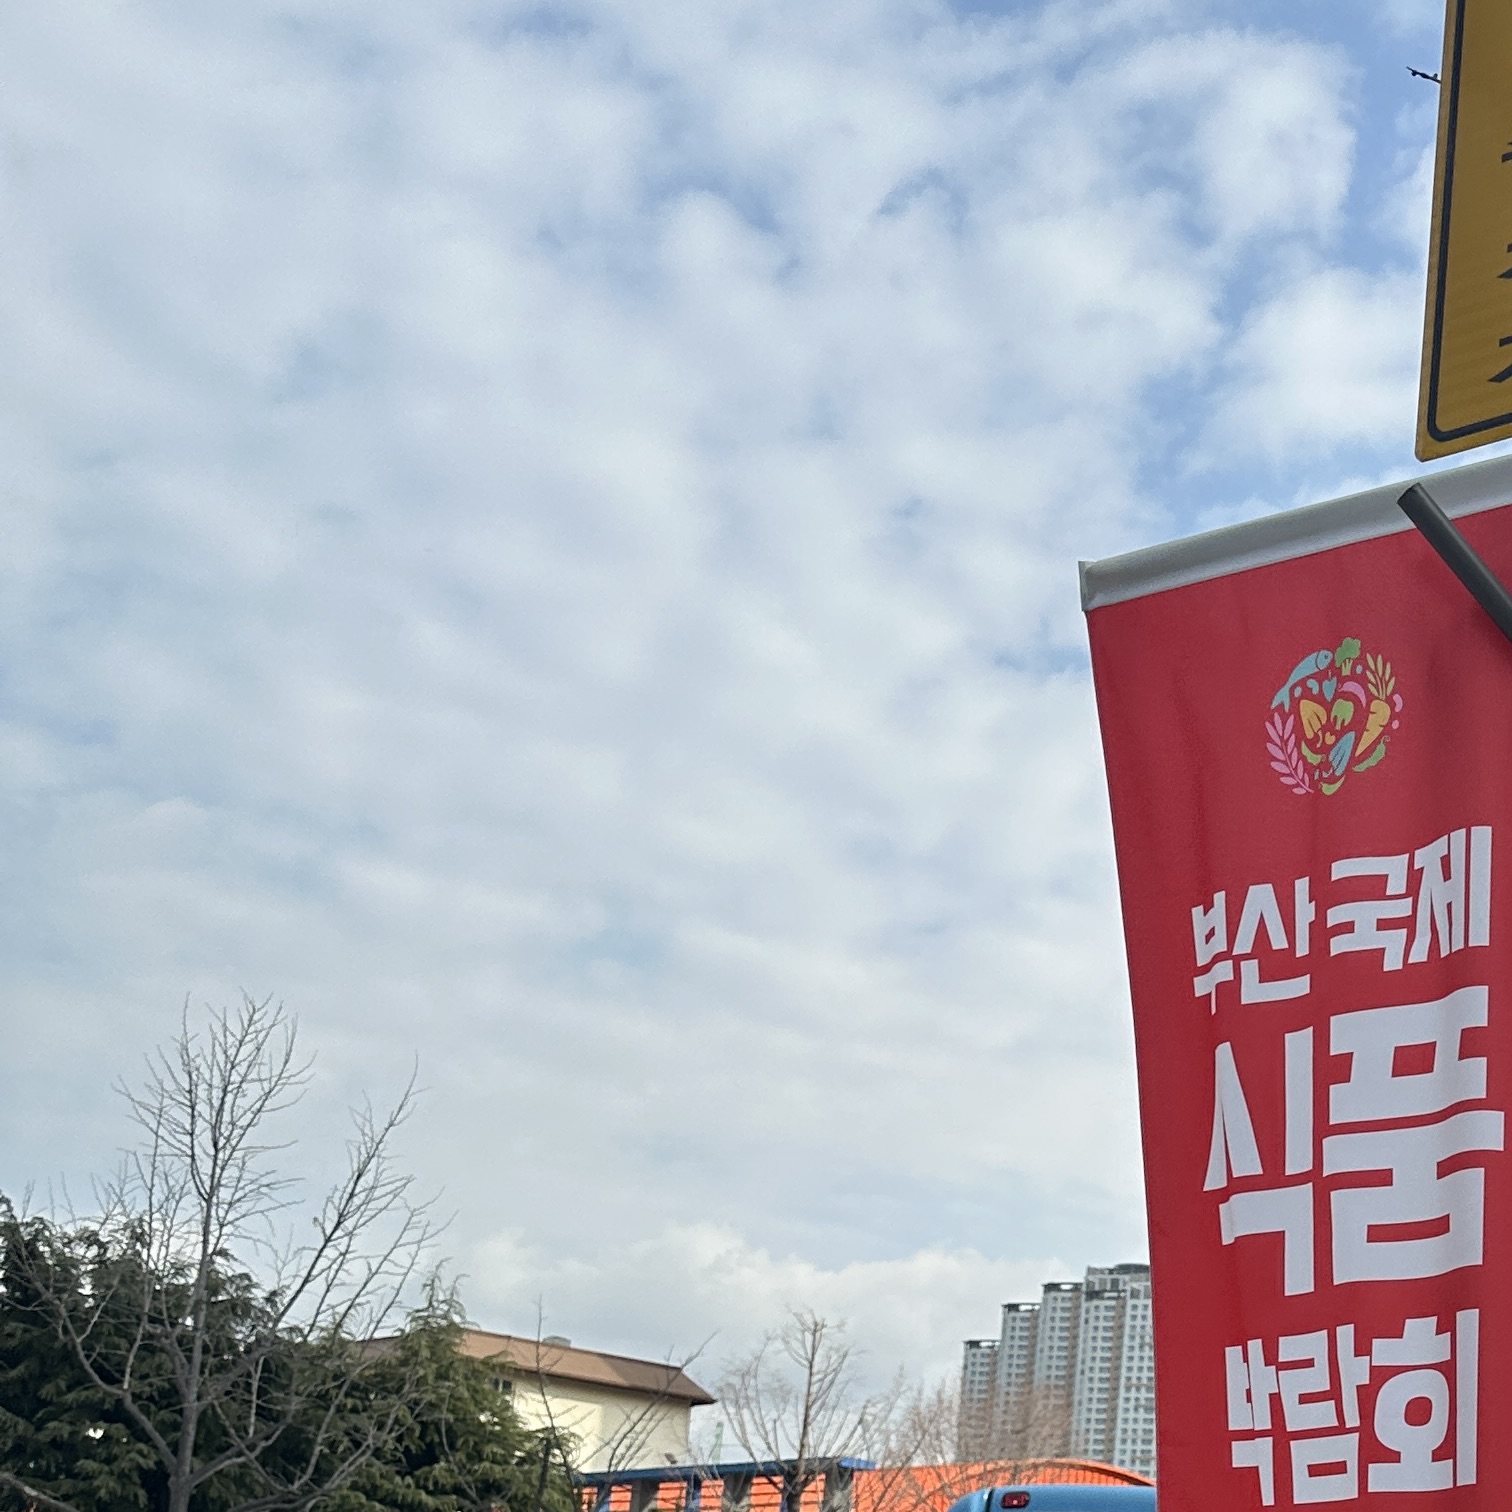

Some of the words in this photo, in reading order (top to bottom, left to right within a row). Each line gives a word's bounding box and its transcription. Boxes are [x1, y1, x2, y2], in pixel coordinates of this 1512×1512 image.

[1190, 825, 1493, 1016] 부산국제
[1202, 984, 1505, 1298] 식품
[1223, 1307, 1480, 1508] 박람회
